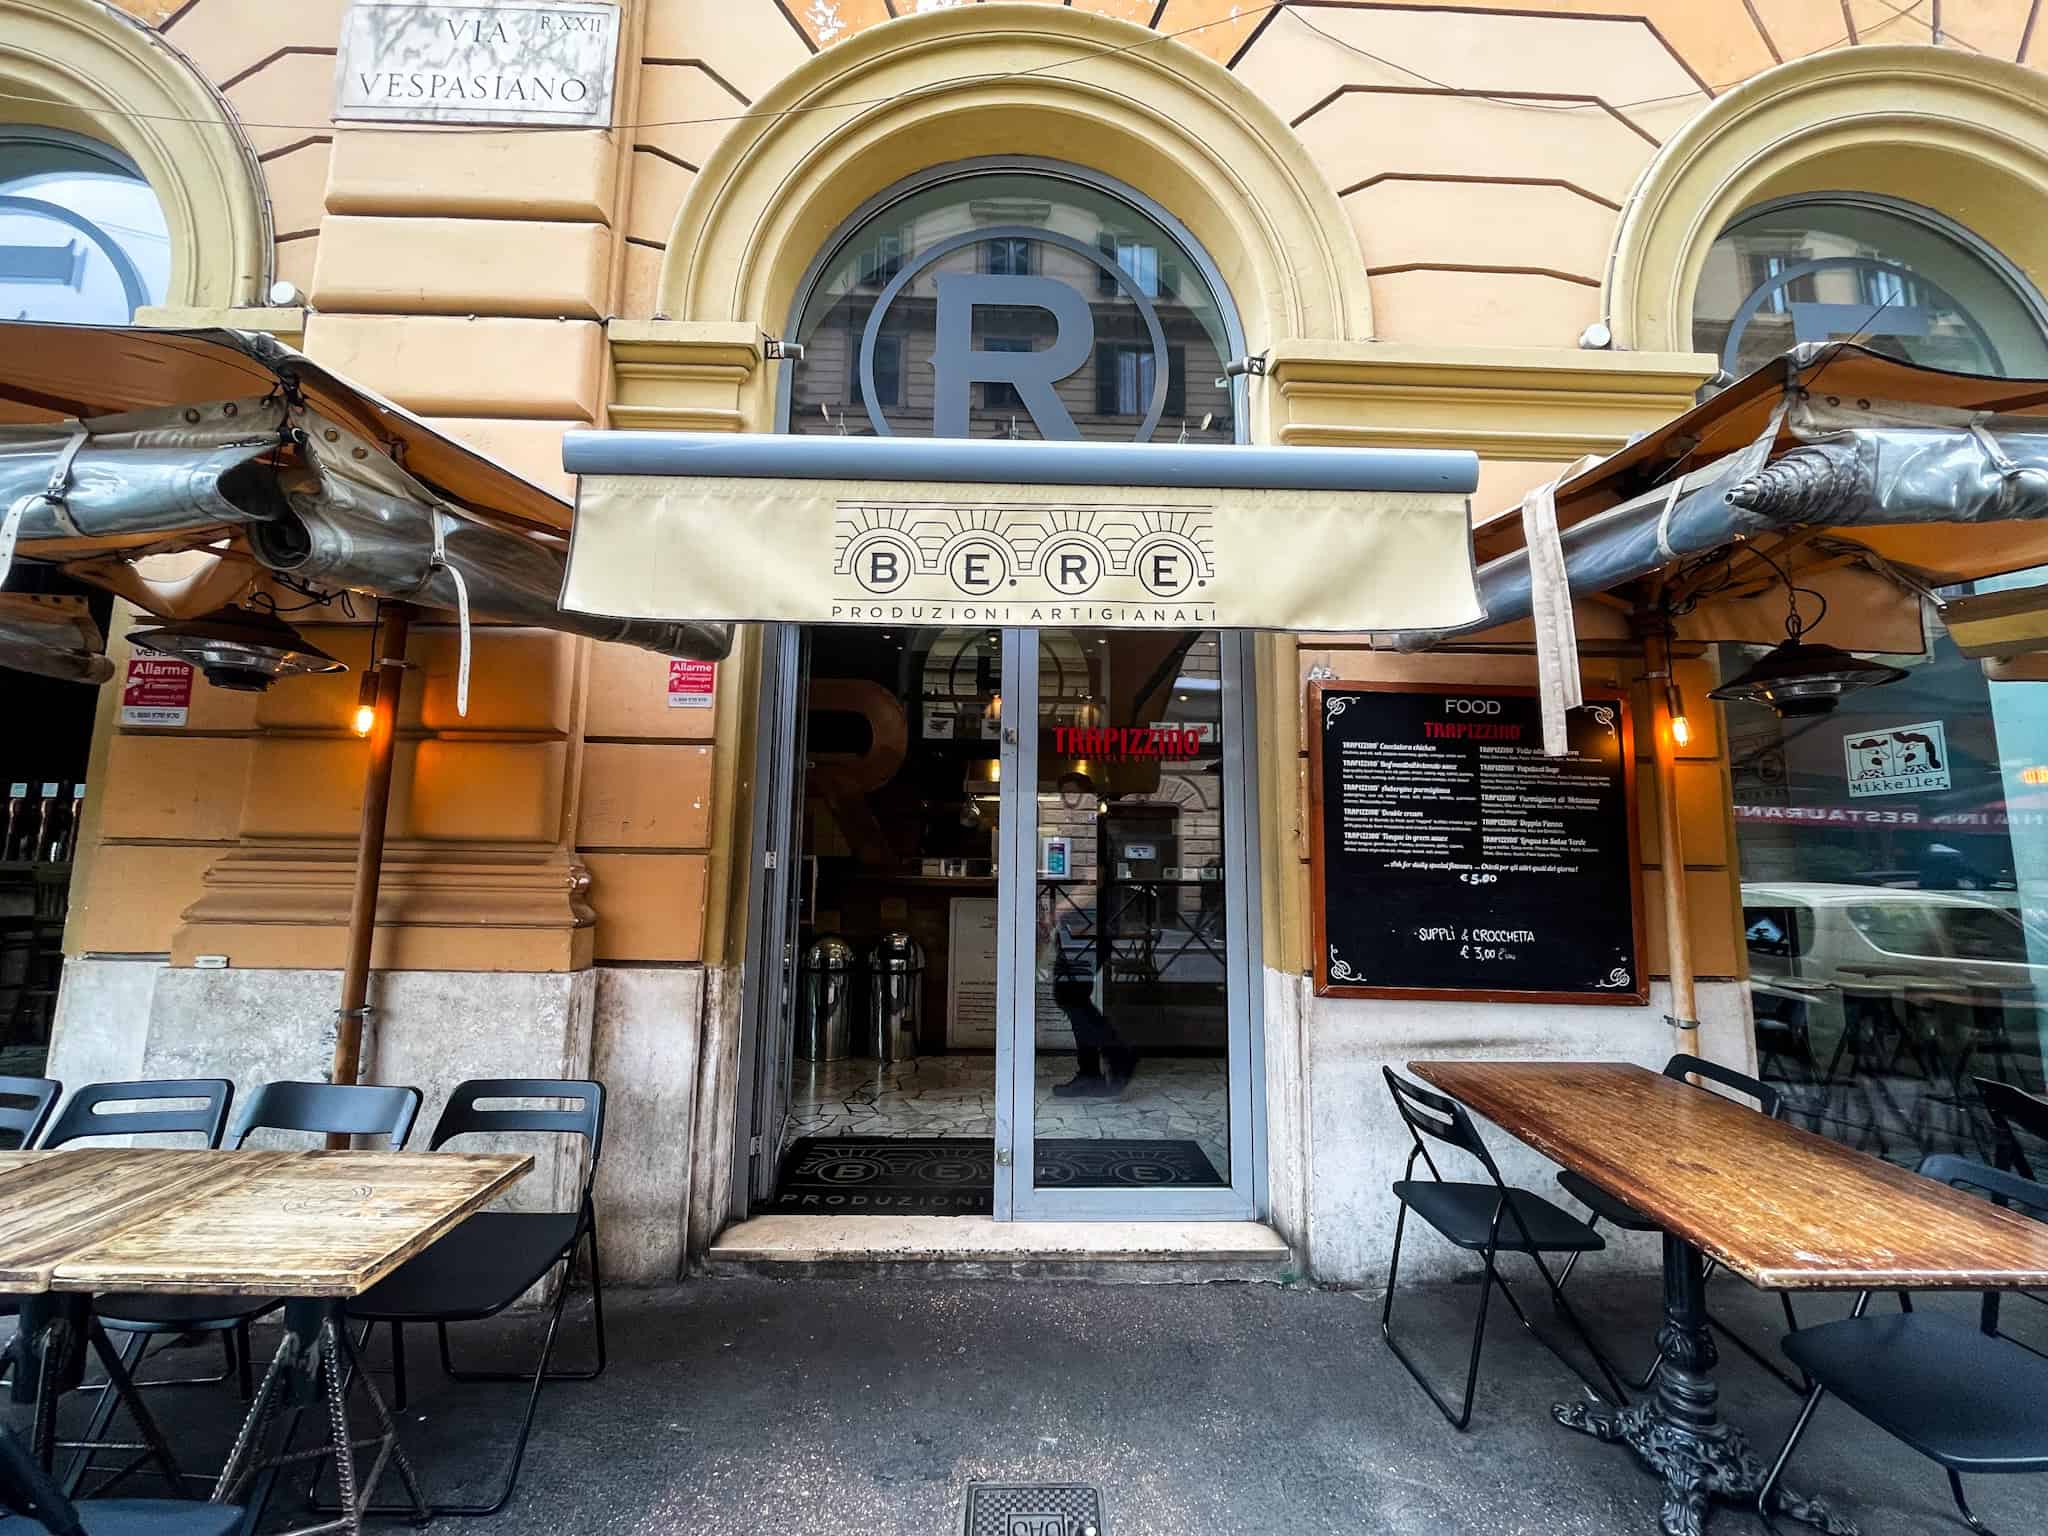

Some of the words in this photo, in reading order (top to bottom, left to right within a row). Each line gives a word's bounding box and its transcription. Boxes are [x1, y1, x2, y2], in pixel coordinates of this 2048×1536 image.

[447, 19, 508, 44] VIA
[359, 72, 587, 103] VESPASIANO
[831, 605, 1011, 620] PRODUZIONI
[1030, 606, 1217, 622] ARTIGIANALI
[132, 662, 190, 676] Allarme
[672, 662, 713, 672] Allarme
[1445, 699, 1501, 714] FOOD
[1424, 721, 1521, 739] TRAPIZZINO
[1052, 725, 1202, 755] TRAPIZZINO
[1472, 929, 1536, 943] CROCCHETTA
